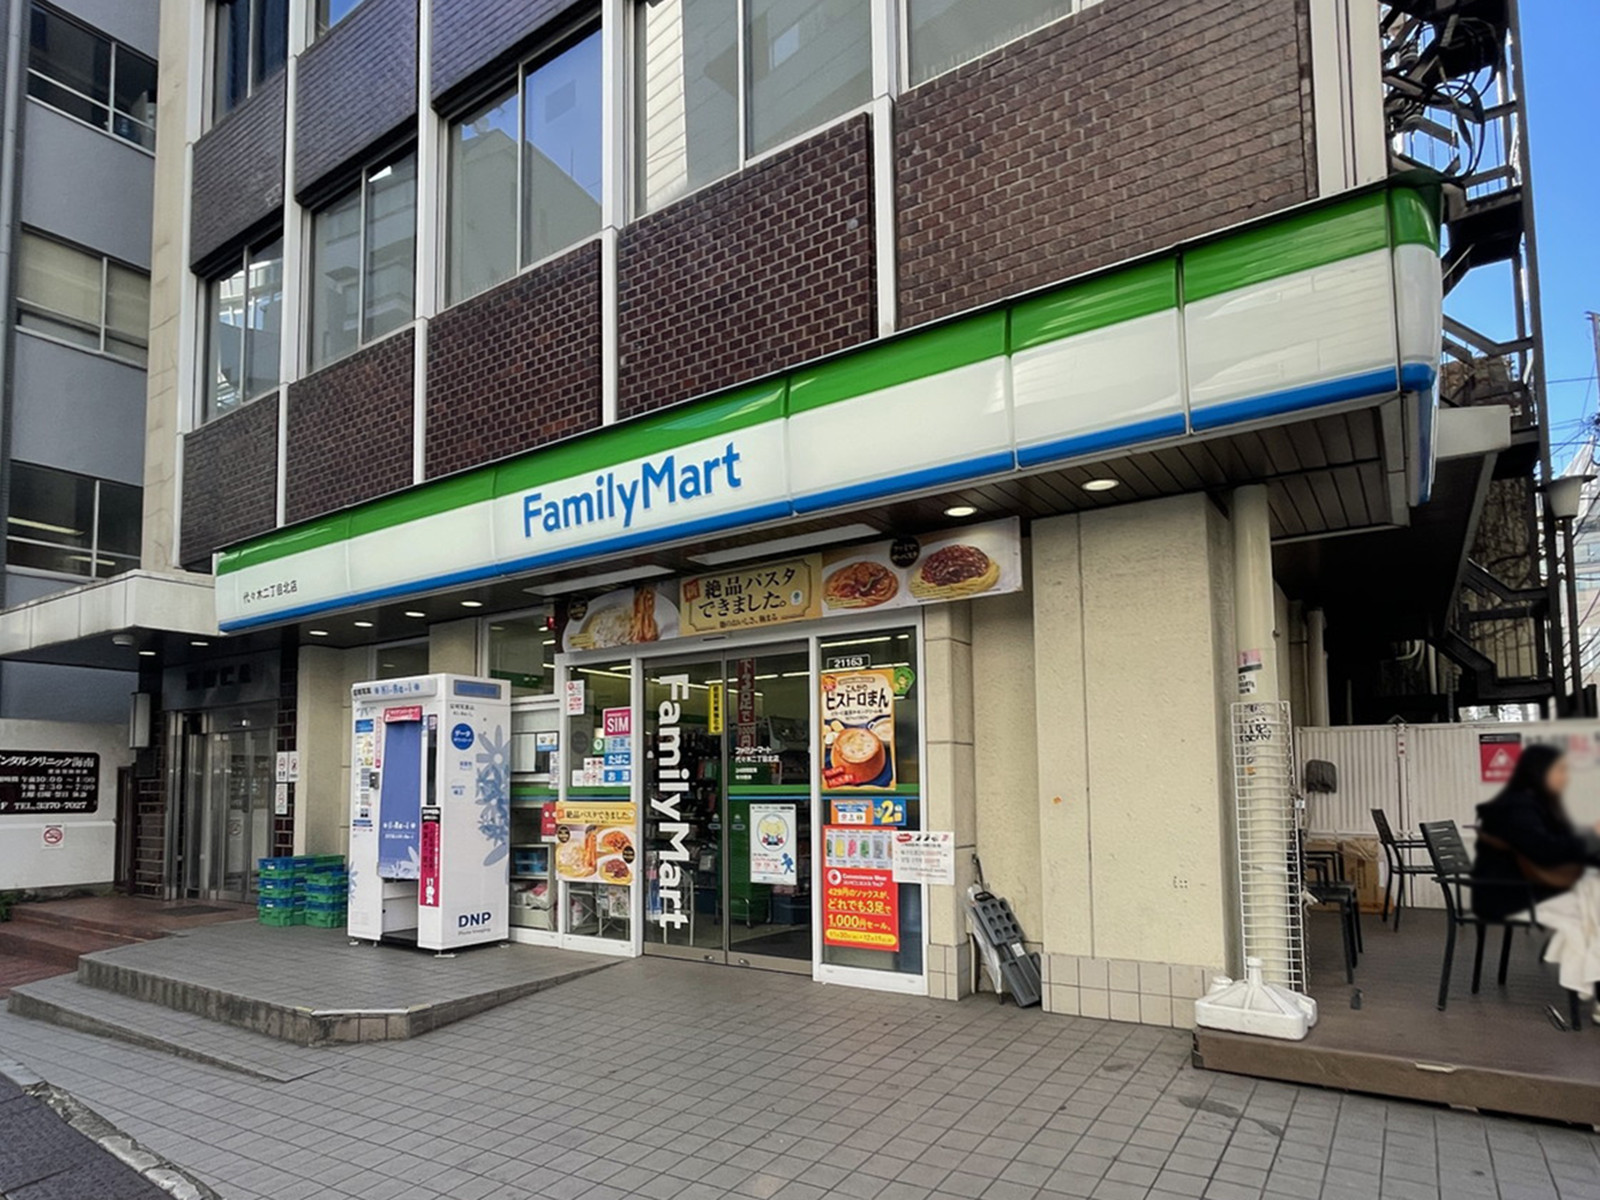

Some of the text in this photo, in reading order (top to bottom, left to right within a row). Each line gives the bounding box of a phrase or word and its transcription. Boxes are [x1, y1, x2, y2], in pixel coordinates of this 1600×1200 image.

[523, 442, 742, 538] FamilyMart
[243, 580, 298, 603] 代々木二丁目北店
[704, 567, 796, 600] 絶品パスタ
[698, 591, 787, 618] できました。
[834, 657, 863, 668] 21163
[607, 717, 629, 732] SIM
[650, 673, 690, 929] FamilyMart
[828, 898, 892, 914] どれでも3足で
[458, 911, 492, 928] DNP
